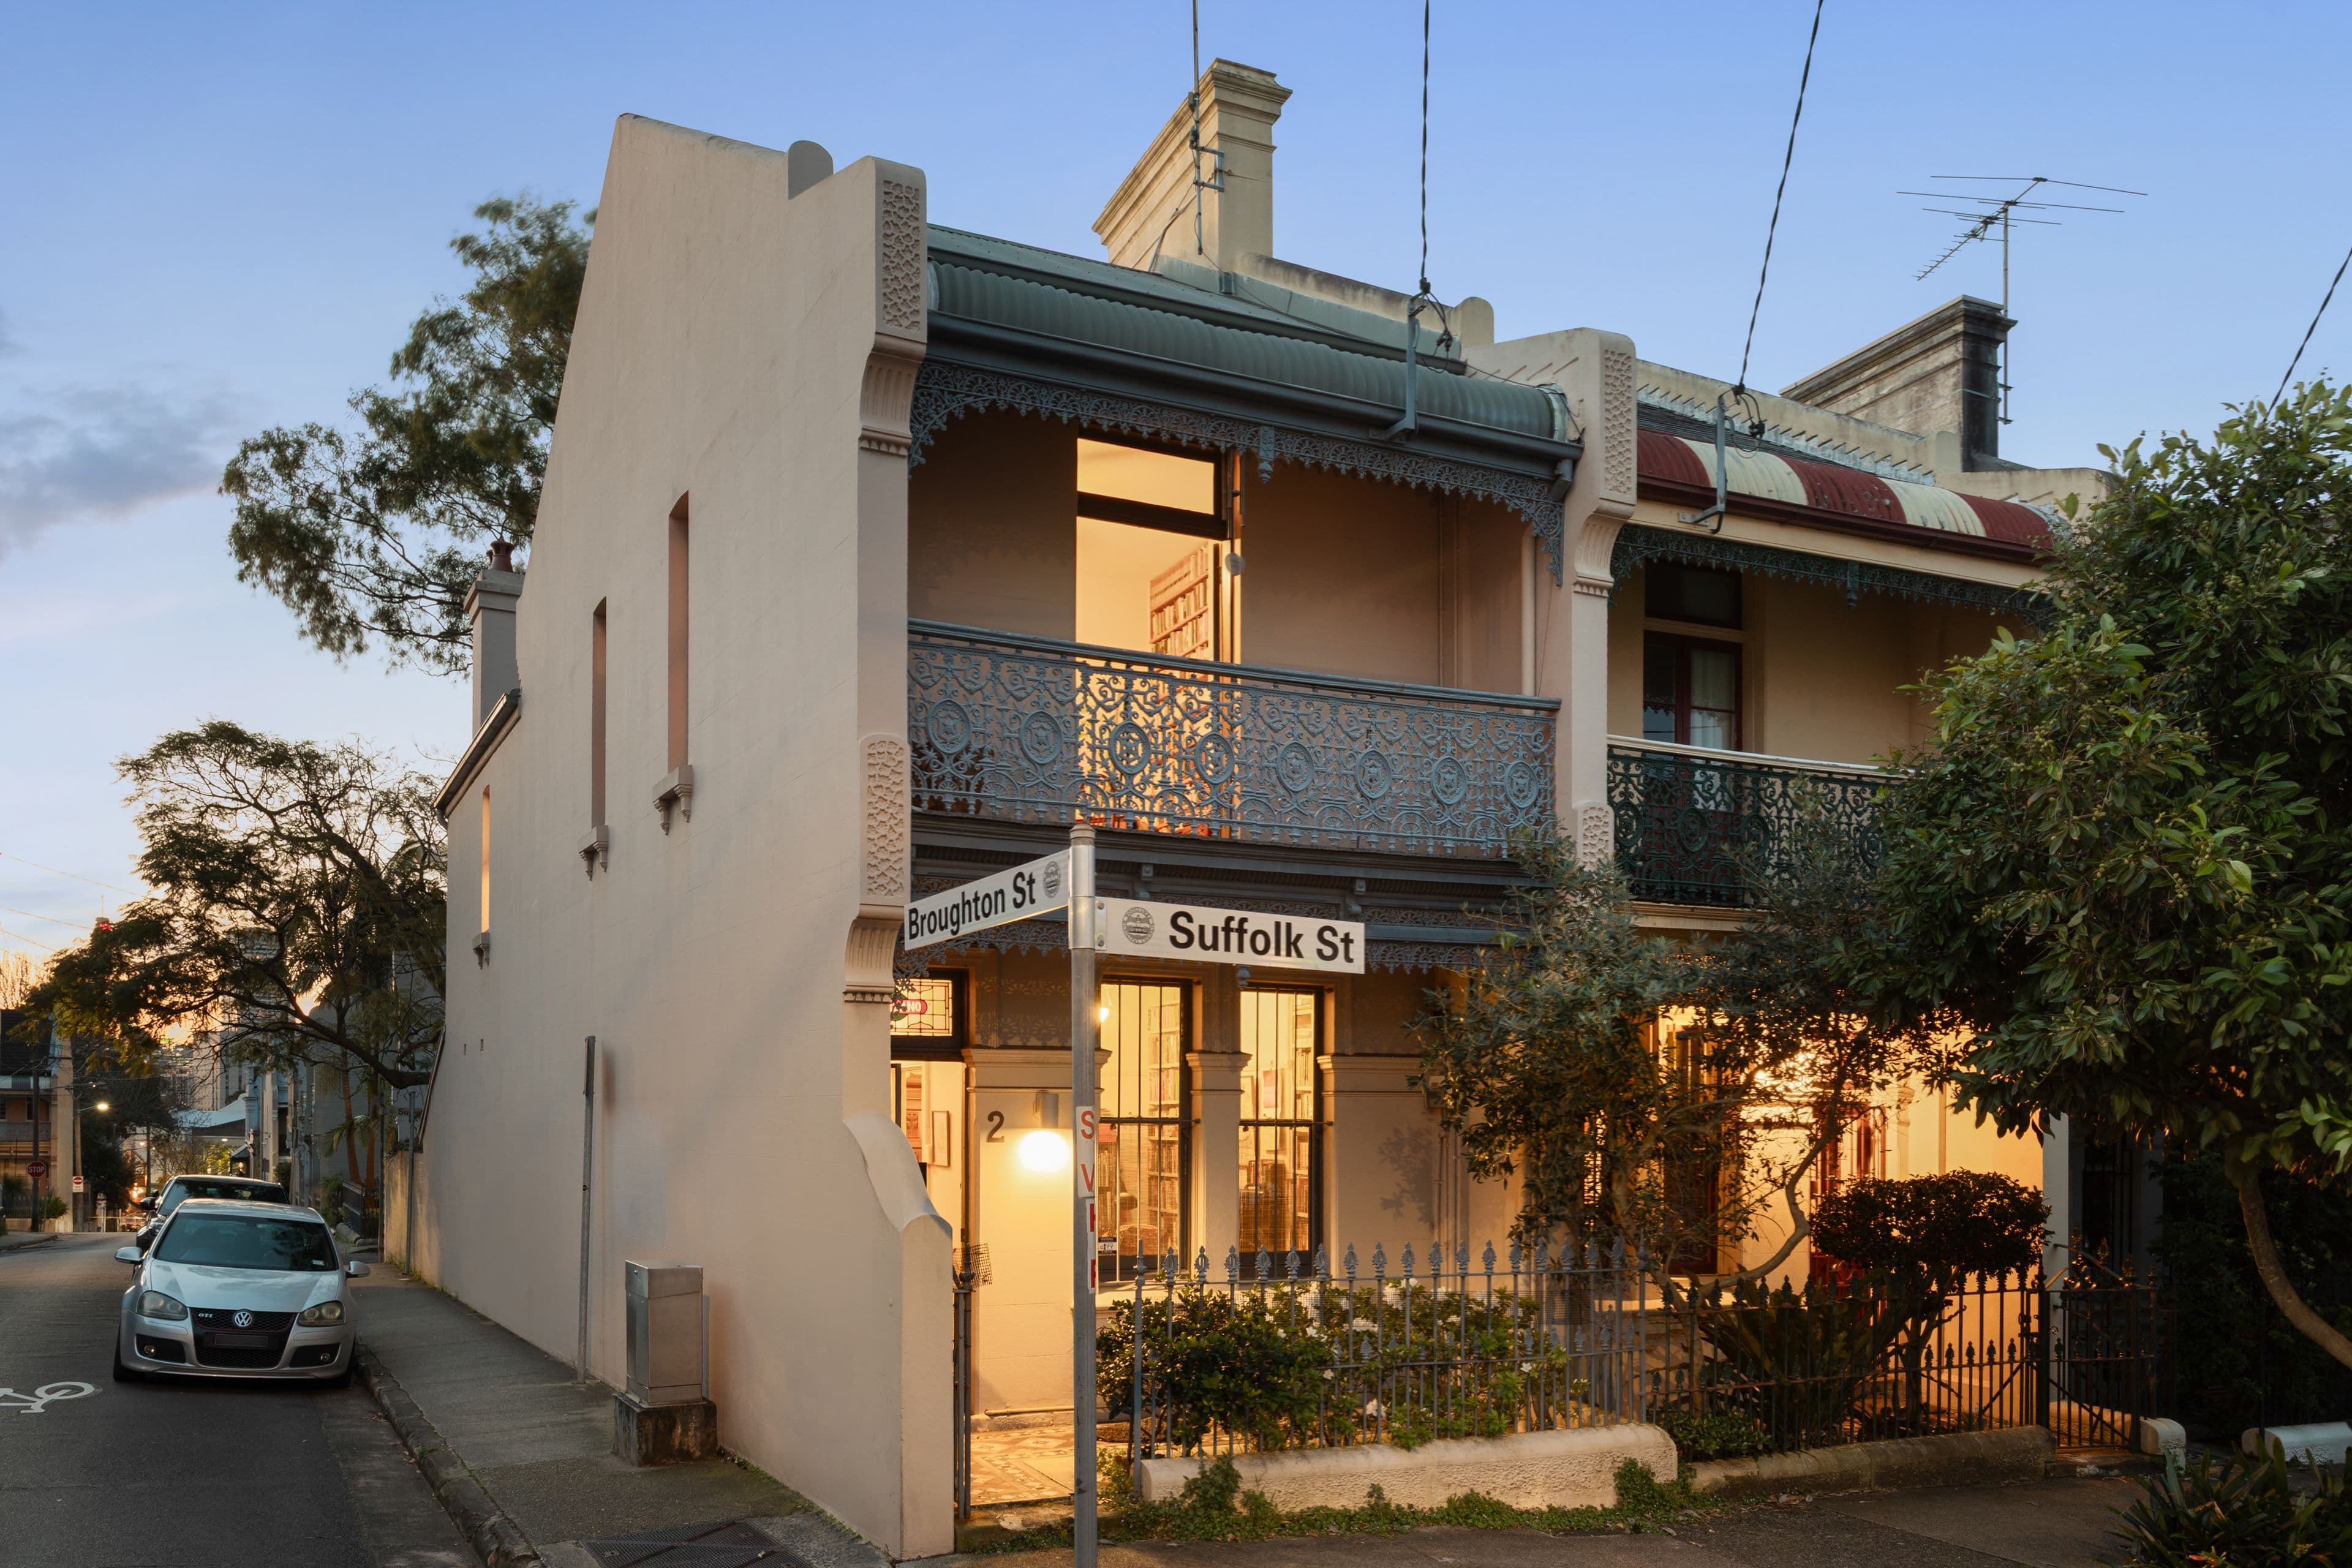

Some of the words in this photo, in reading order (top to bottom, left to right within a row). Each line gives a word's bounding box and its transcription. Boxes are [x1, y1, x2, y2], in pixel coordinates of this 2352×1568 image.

[908, 888, 1005, 940] Broughton
[1012, 871, 1036, 909] St
[1169, 910, 1304, 959] Suffolk
[1316, 925, 1354, 963] St
[986, 1110, 1005, 1143] 2
